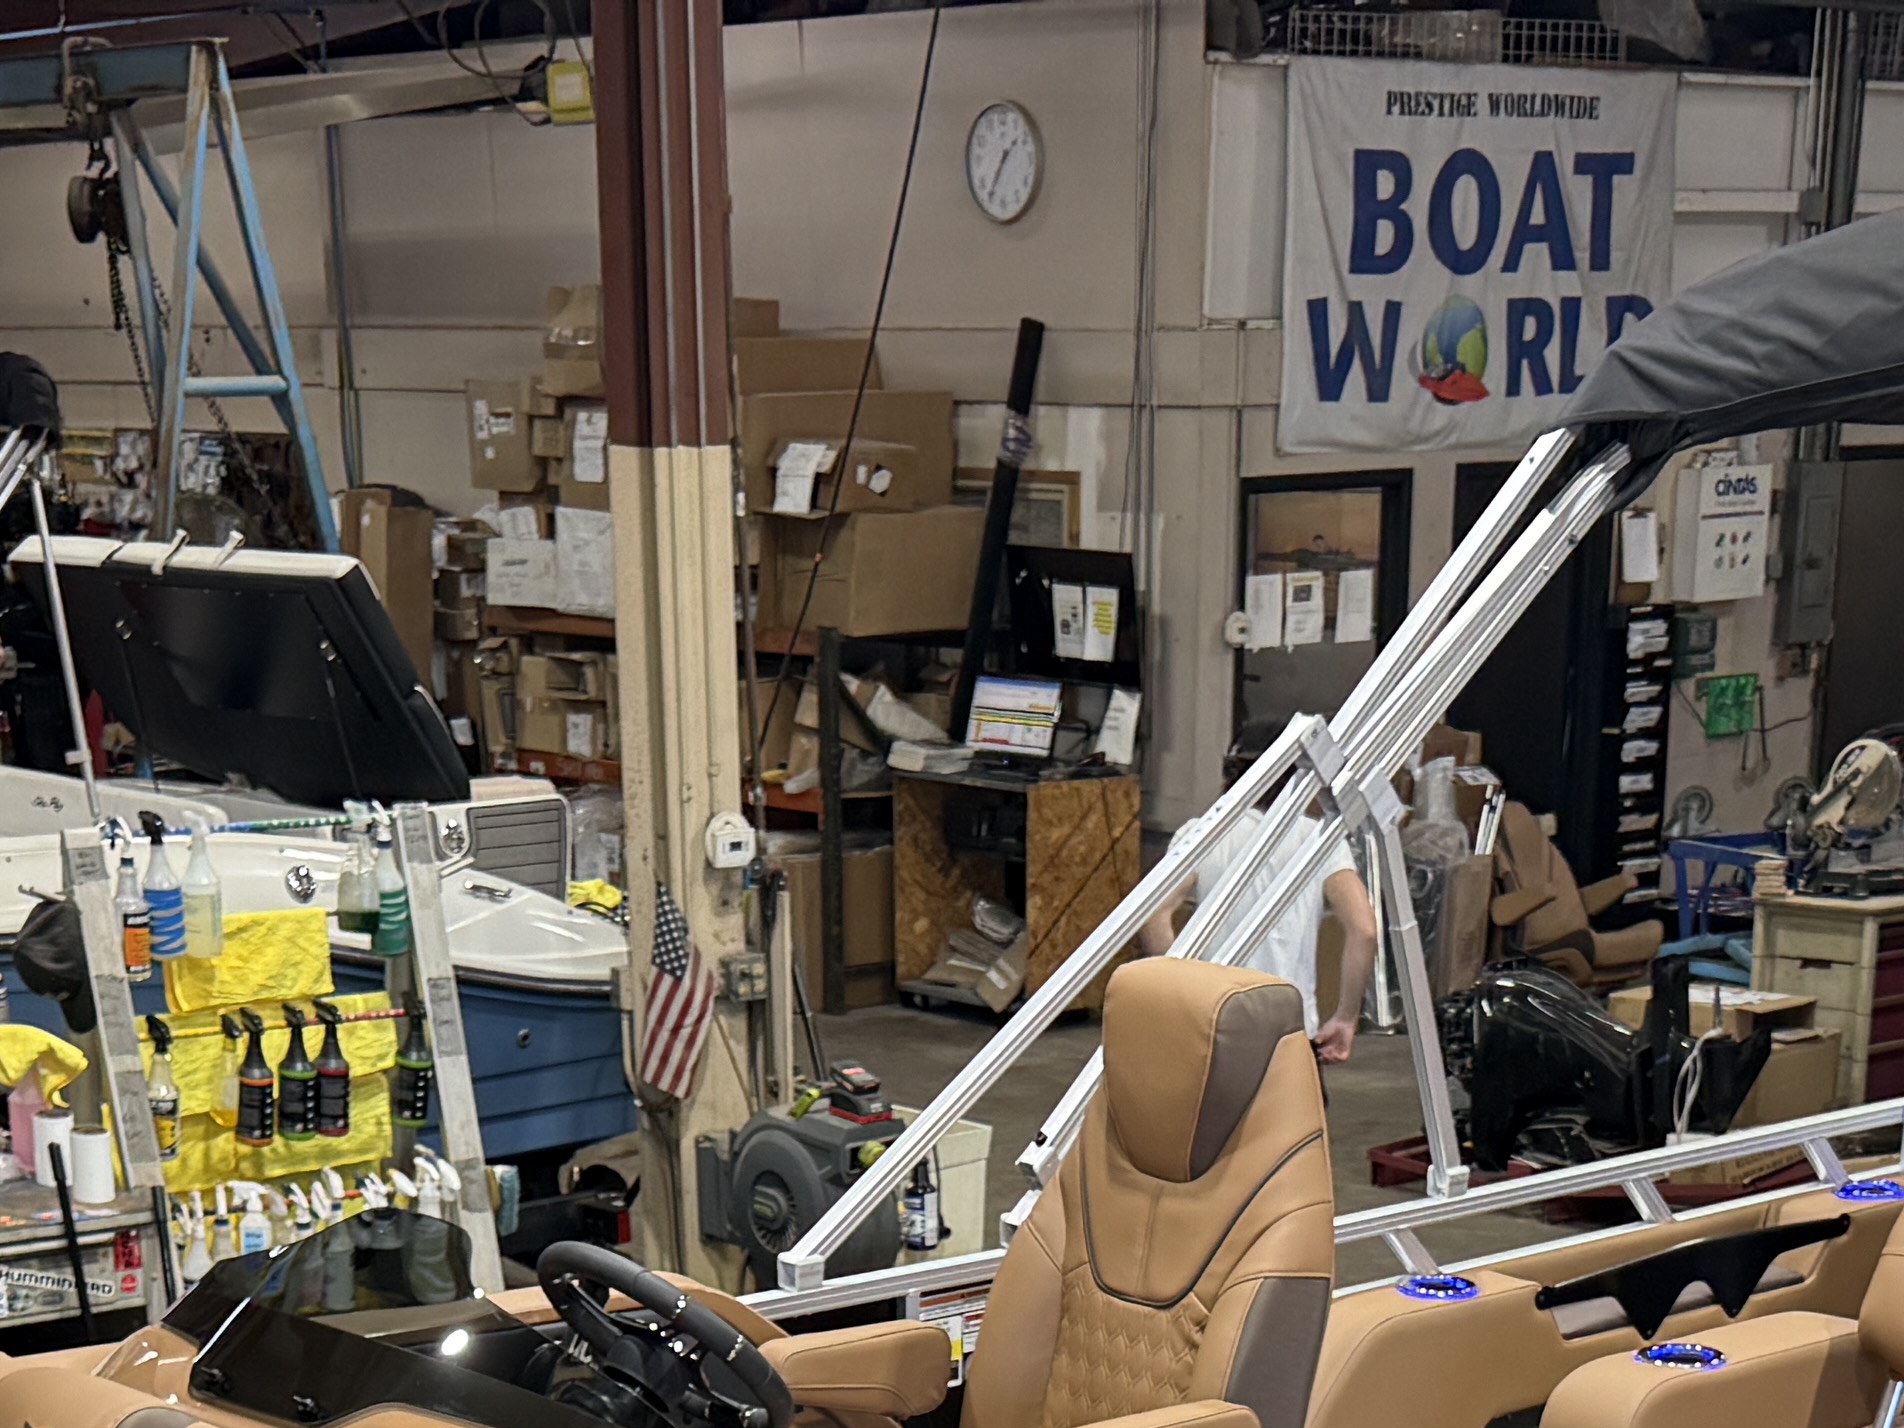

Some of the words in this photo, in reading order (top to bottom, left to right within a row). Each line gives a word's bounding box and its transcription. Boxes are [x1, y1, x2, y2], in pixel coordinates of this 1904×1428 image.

[1386, 90, 1478, 117] PRESTIGE
[1487, 92, 1601, 120] WORLDWIDE
[1349, 148, 1635, 275] BOAT
